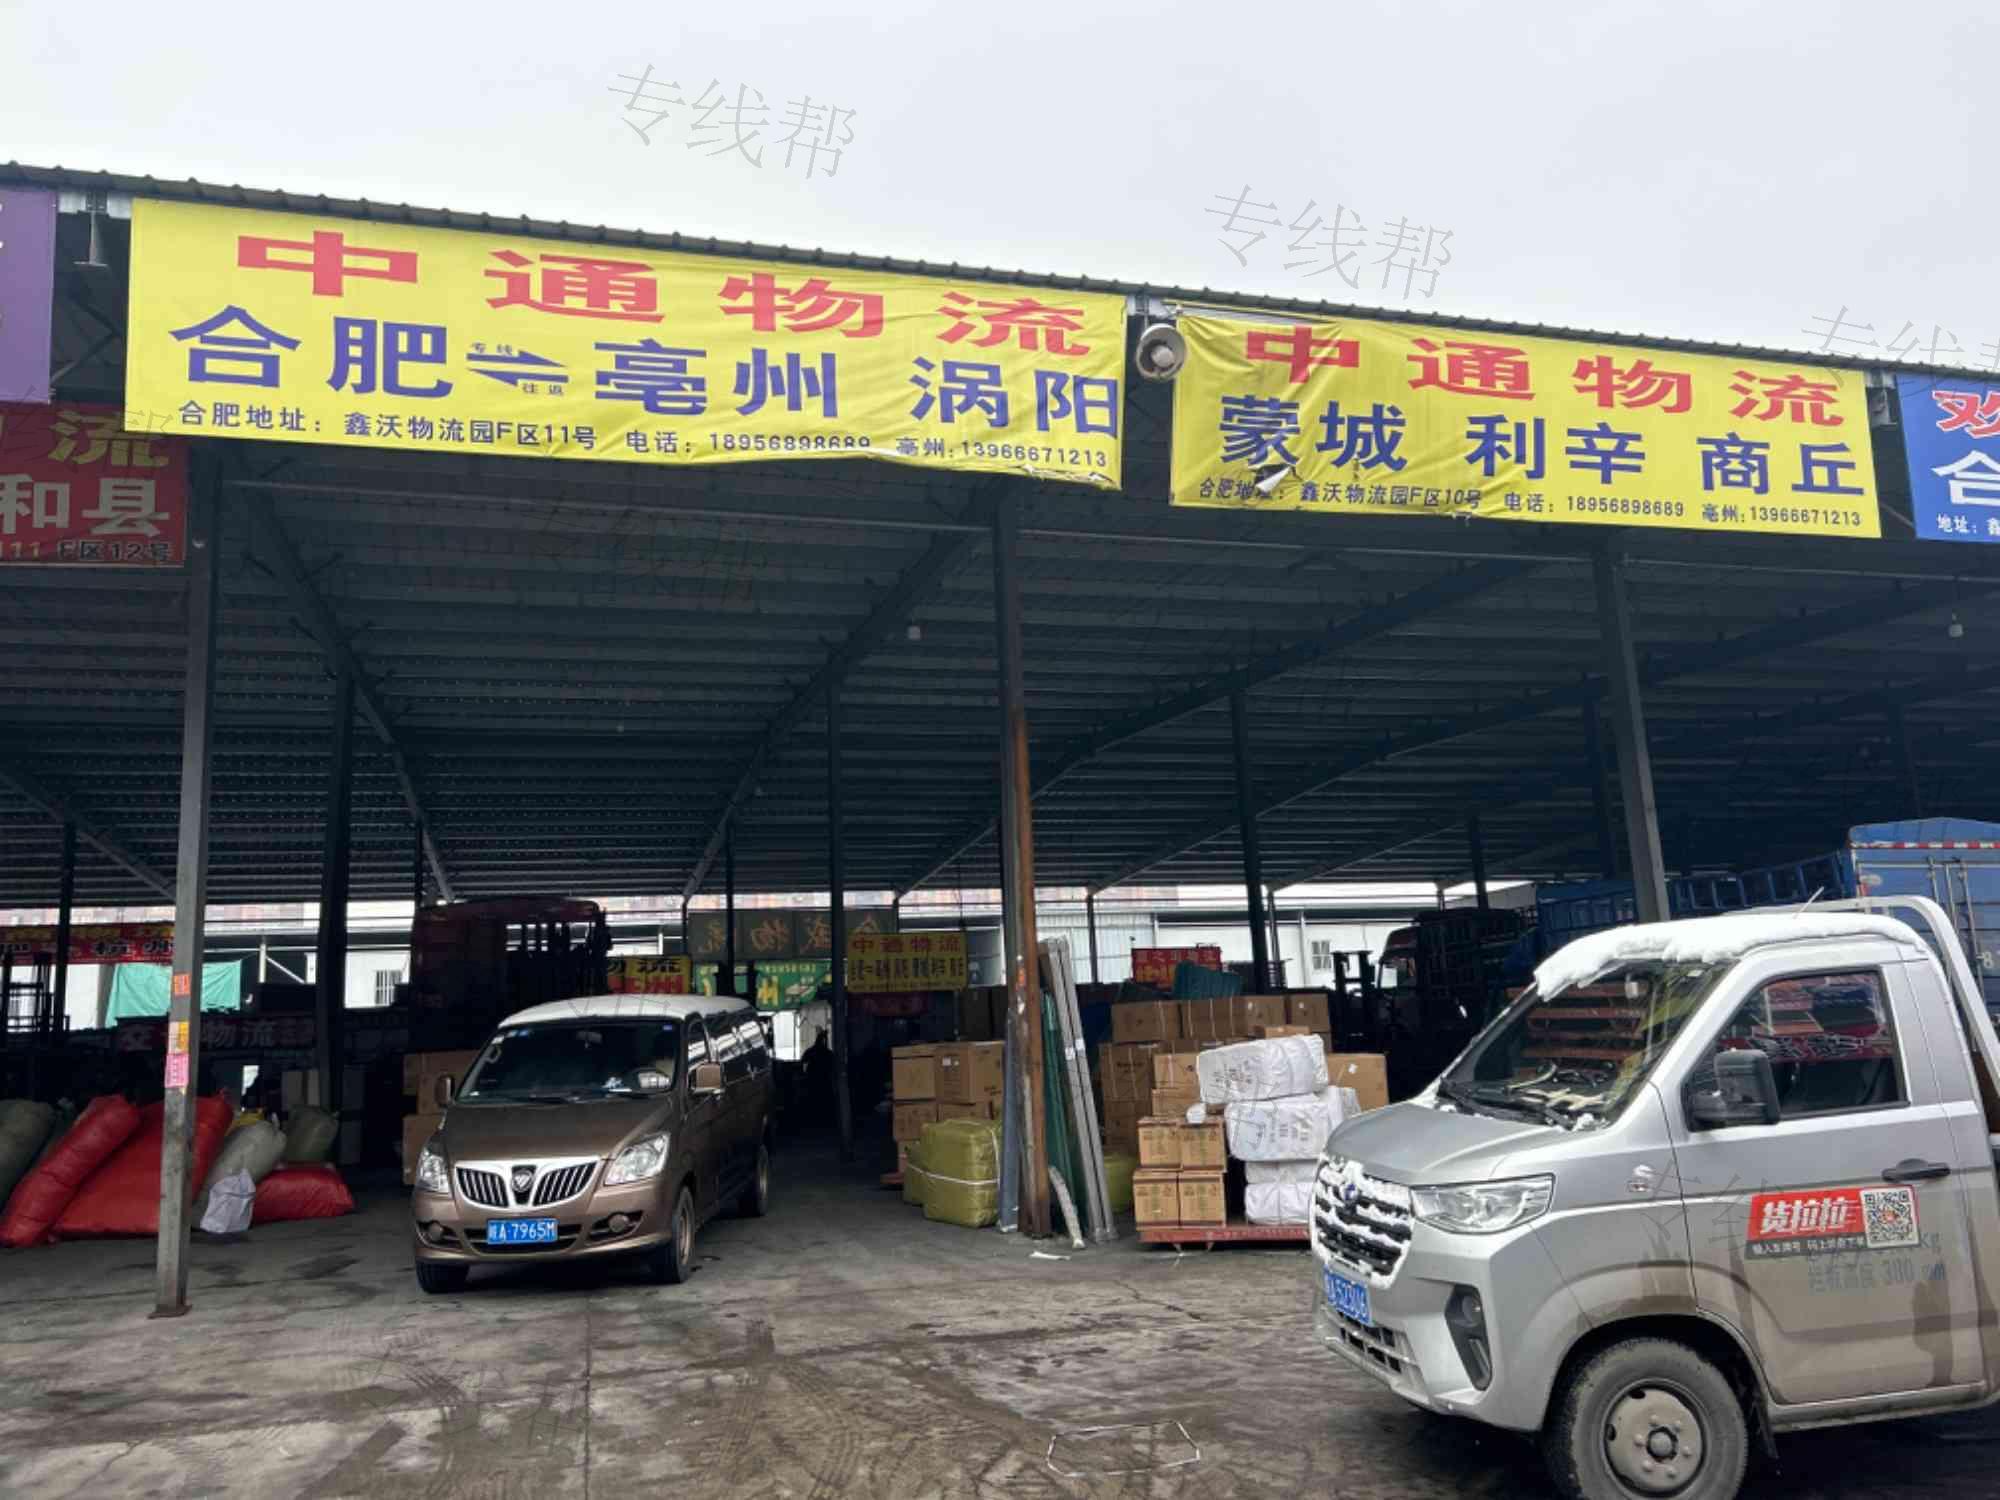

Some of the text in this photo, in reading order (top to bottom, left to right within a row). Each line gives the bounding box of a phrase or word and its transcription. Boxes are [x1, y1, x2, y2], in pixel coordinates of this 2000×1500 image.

[237, 230, 1091, 356] 中通物流
[168, 304, 453, 398] 合肥
[908, 356, 1119, 440] 涡阳
[1246, 325, 1844, 427] 中通物流
[1219, 394, 1865, 496] 蒙城 利辛 商丘
[0, 474, 170, 536] 和县
[1760, 1196, 1848, 1234] 货拉拉
